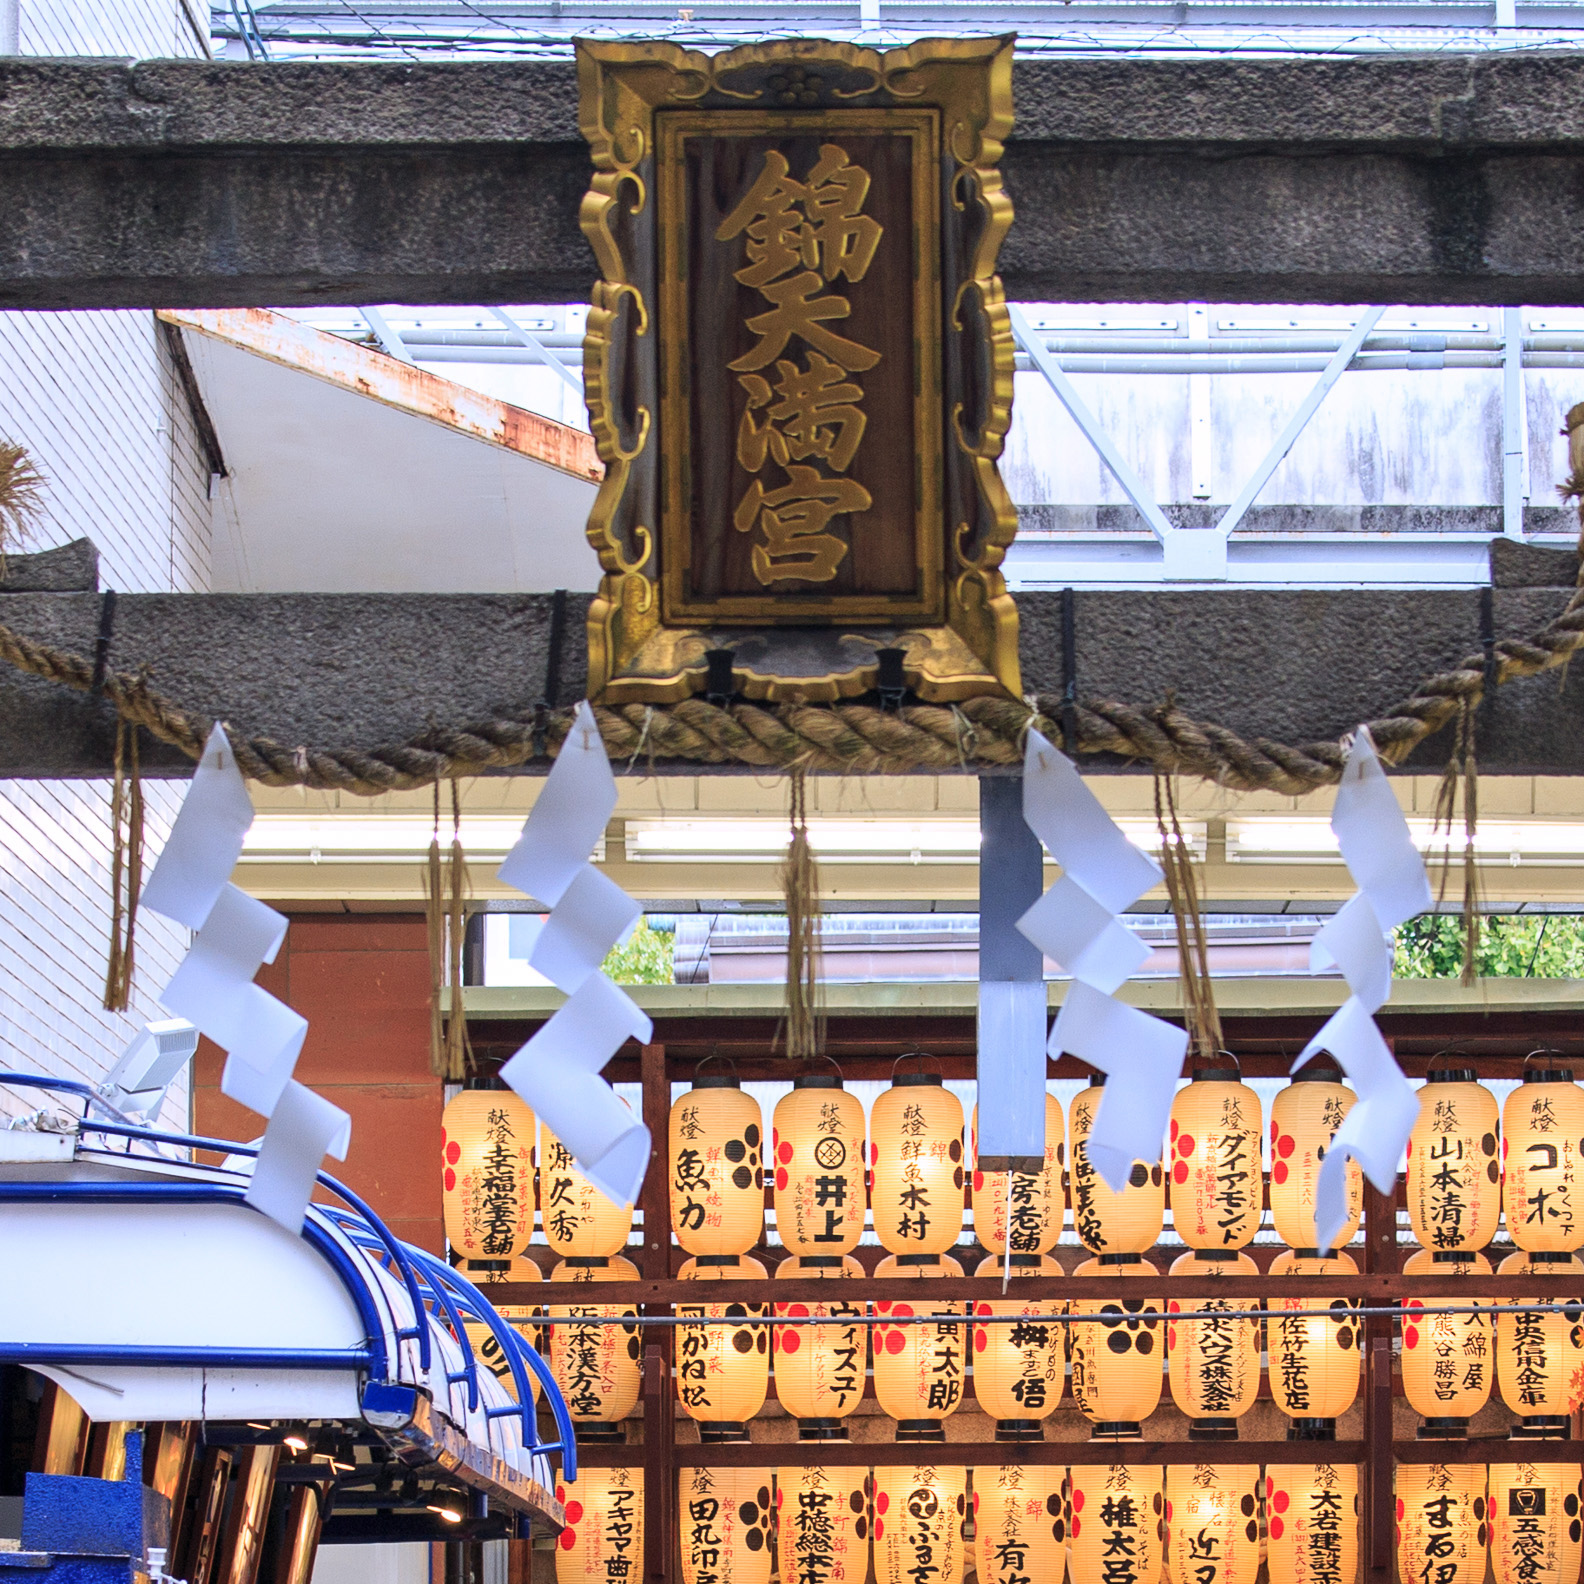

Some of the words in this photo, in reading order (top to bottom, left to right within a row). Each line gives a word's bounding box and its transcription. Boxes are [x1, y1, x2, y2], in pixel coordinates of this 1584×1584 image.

[717, 143, 884, 585] 錦天満宮
[480, 1144, 518, 1256] 幸福堂老舗
[675, 1149, 711, 1231] 魚力
[814, 1175, 848, 1243] 井上
[896, 1140, 932, 1241] 鮮魚木村
[1006, 1171, 1043, 1252] 房老舗
[1216, 1129, 1250, 1244] ダイアモンド
[1430, 1136, 1467, 1249] 山本清掃
[567, 1306, 602, 1416] 阪本漢方堂
[830, 1302, 861, 1408] ウィズユー
[1197, 1301, 1236, 1412] 積水ハウス株式会社
[1279, 1316, 1311, 1410] 佐竹生花店
[1512, 1312, 1549, 1407] 中央信用金庫
